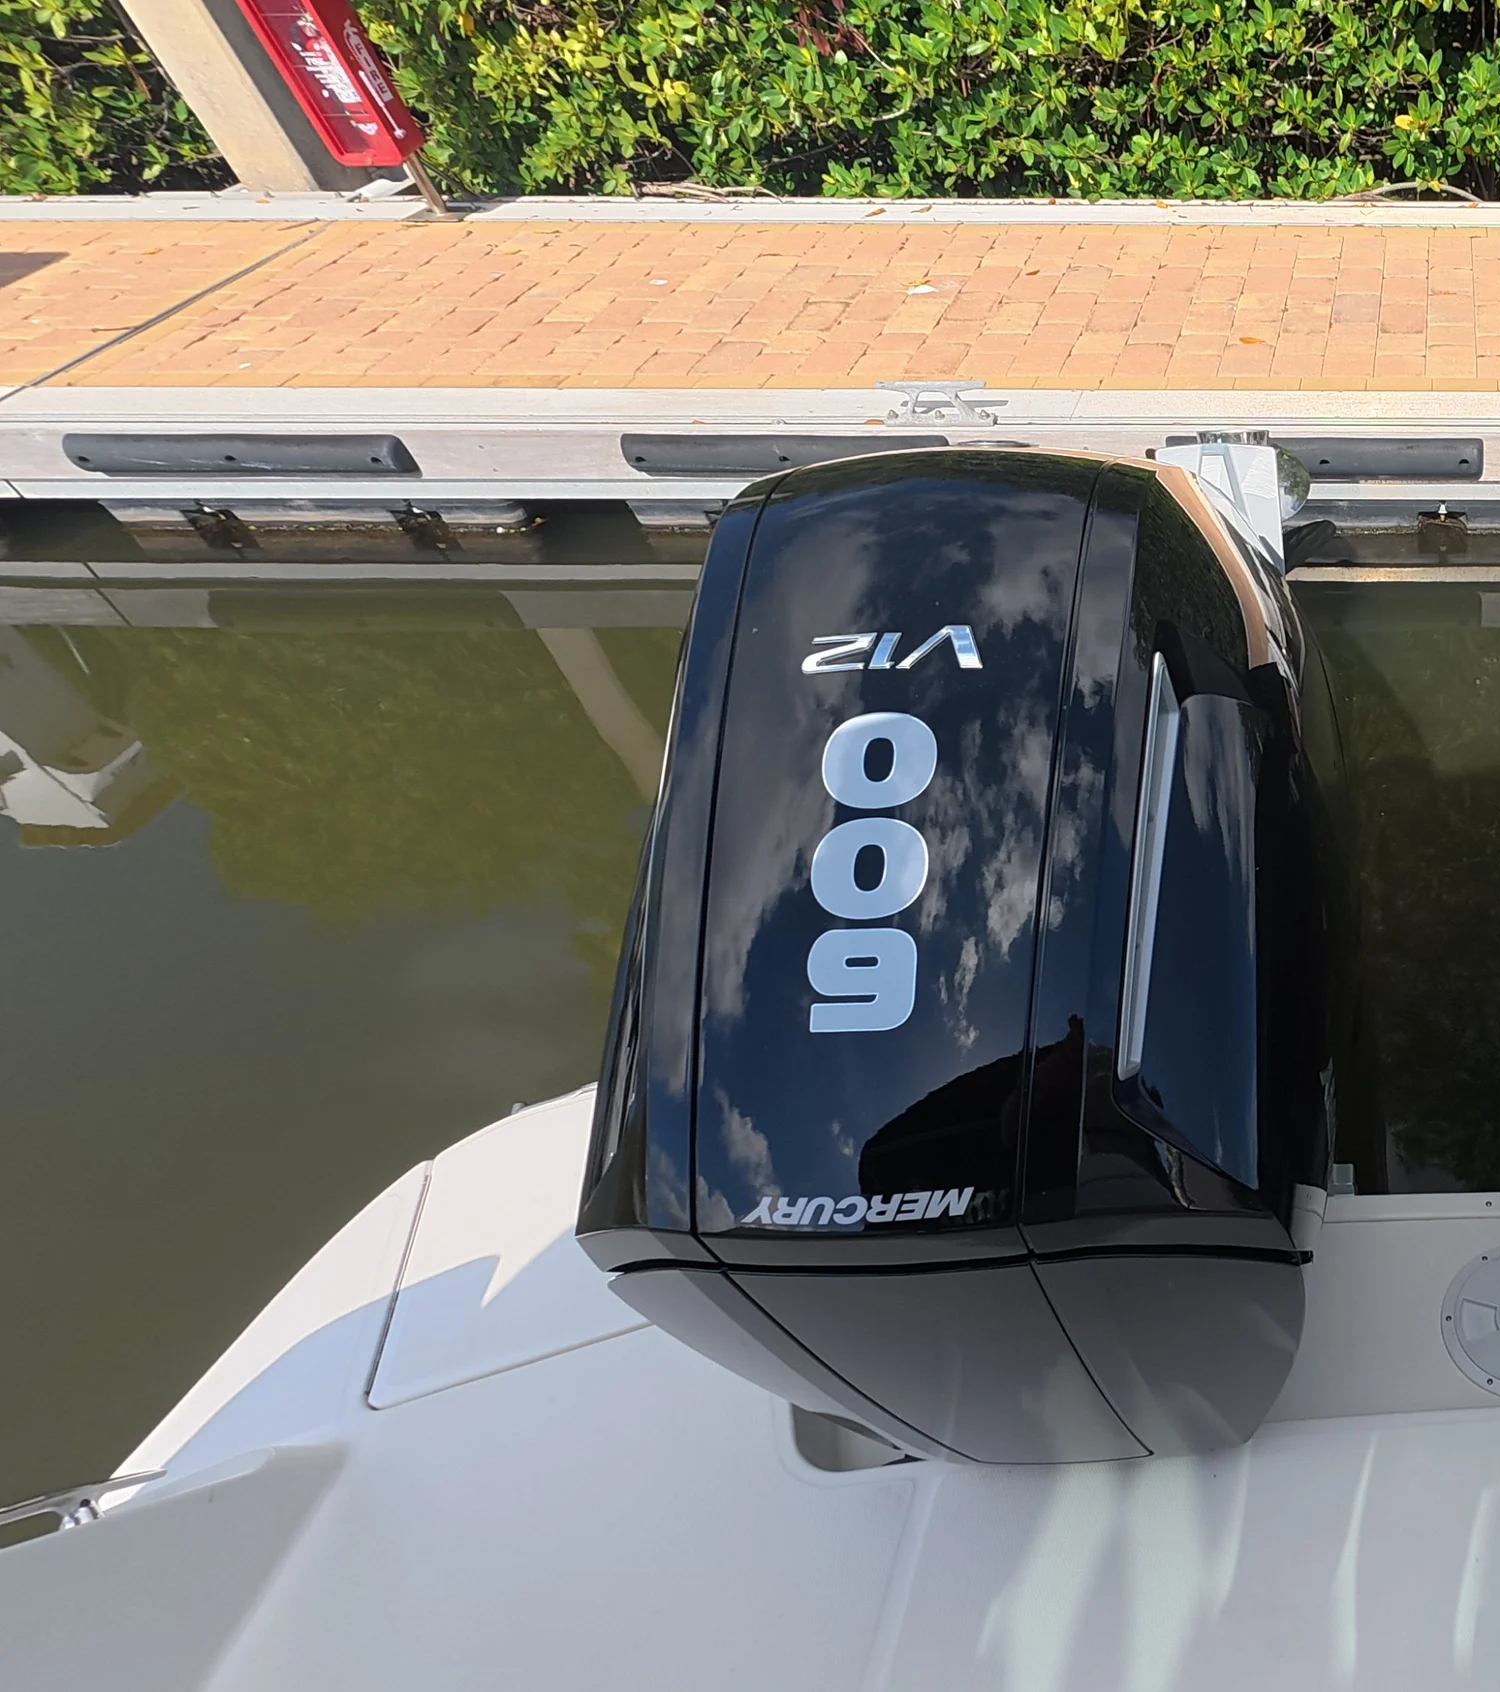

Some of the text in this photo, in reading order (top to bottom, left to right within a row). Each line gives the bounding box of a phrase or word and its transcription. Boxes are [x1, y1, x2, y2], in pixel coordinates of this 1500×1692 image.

[354, 42, 388, 94] FIRE
[801, 624, 983, 674] V12
[806, 711, 938, 1033] 600
[740, 1186, 975, 1225] MERCURY
